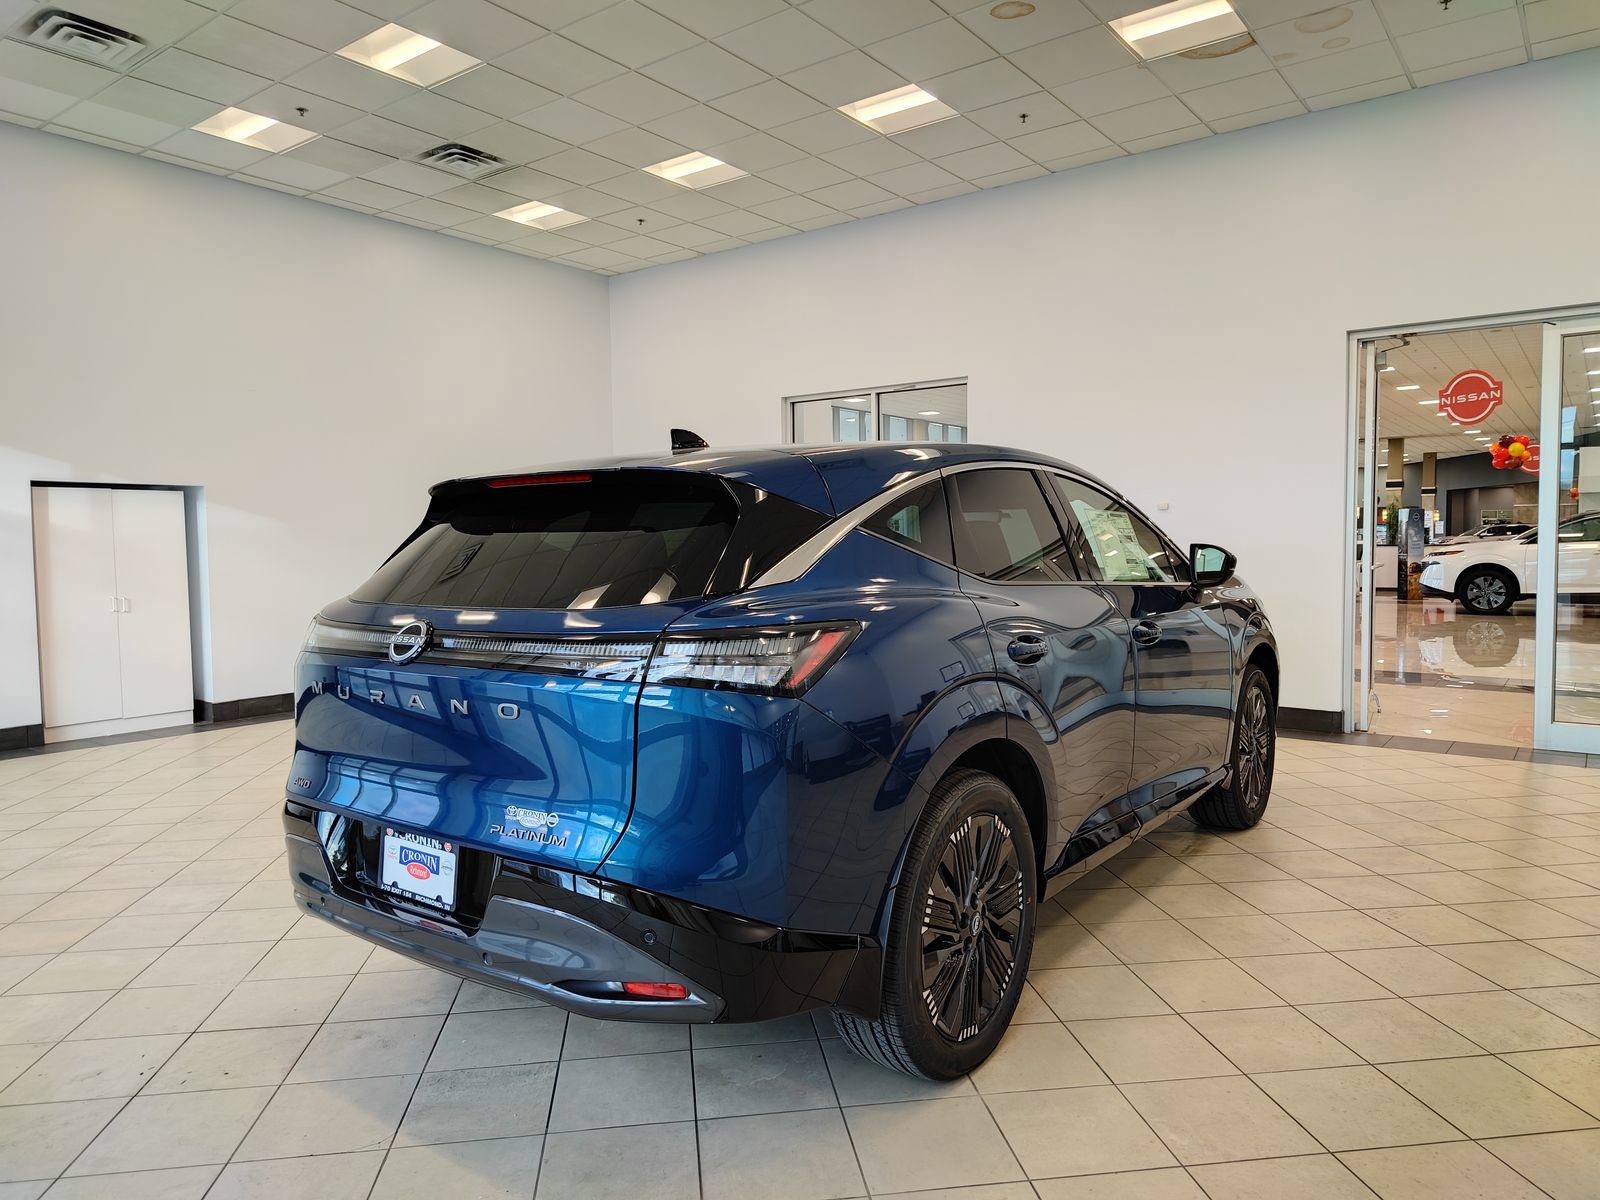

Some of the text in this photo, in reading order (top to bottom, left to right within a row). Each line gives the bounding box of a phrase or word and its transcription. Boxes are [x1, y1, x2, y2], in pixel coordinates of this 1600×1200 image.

[1441, 389, 1501, 406] NISSAN
[391, 635, 424, 644] NISSAN
[311, 680, 520, 720] MURANO
[518, 809, 547, 820] CRONIN
[490, 824, 567, 848] PLATINUM
[401, 848, 438, 872] CRONIN
